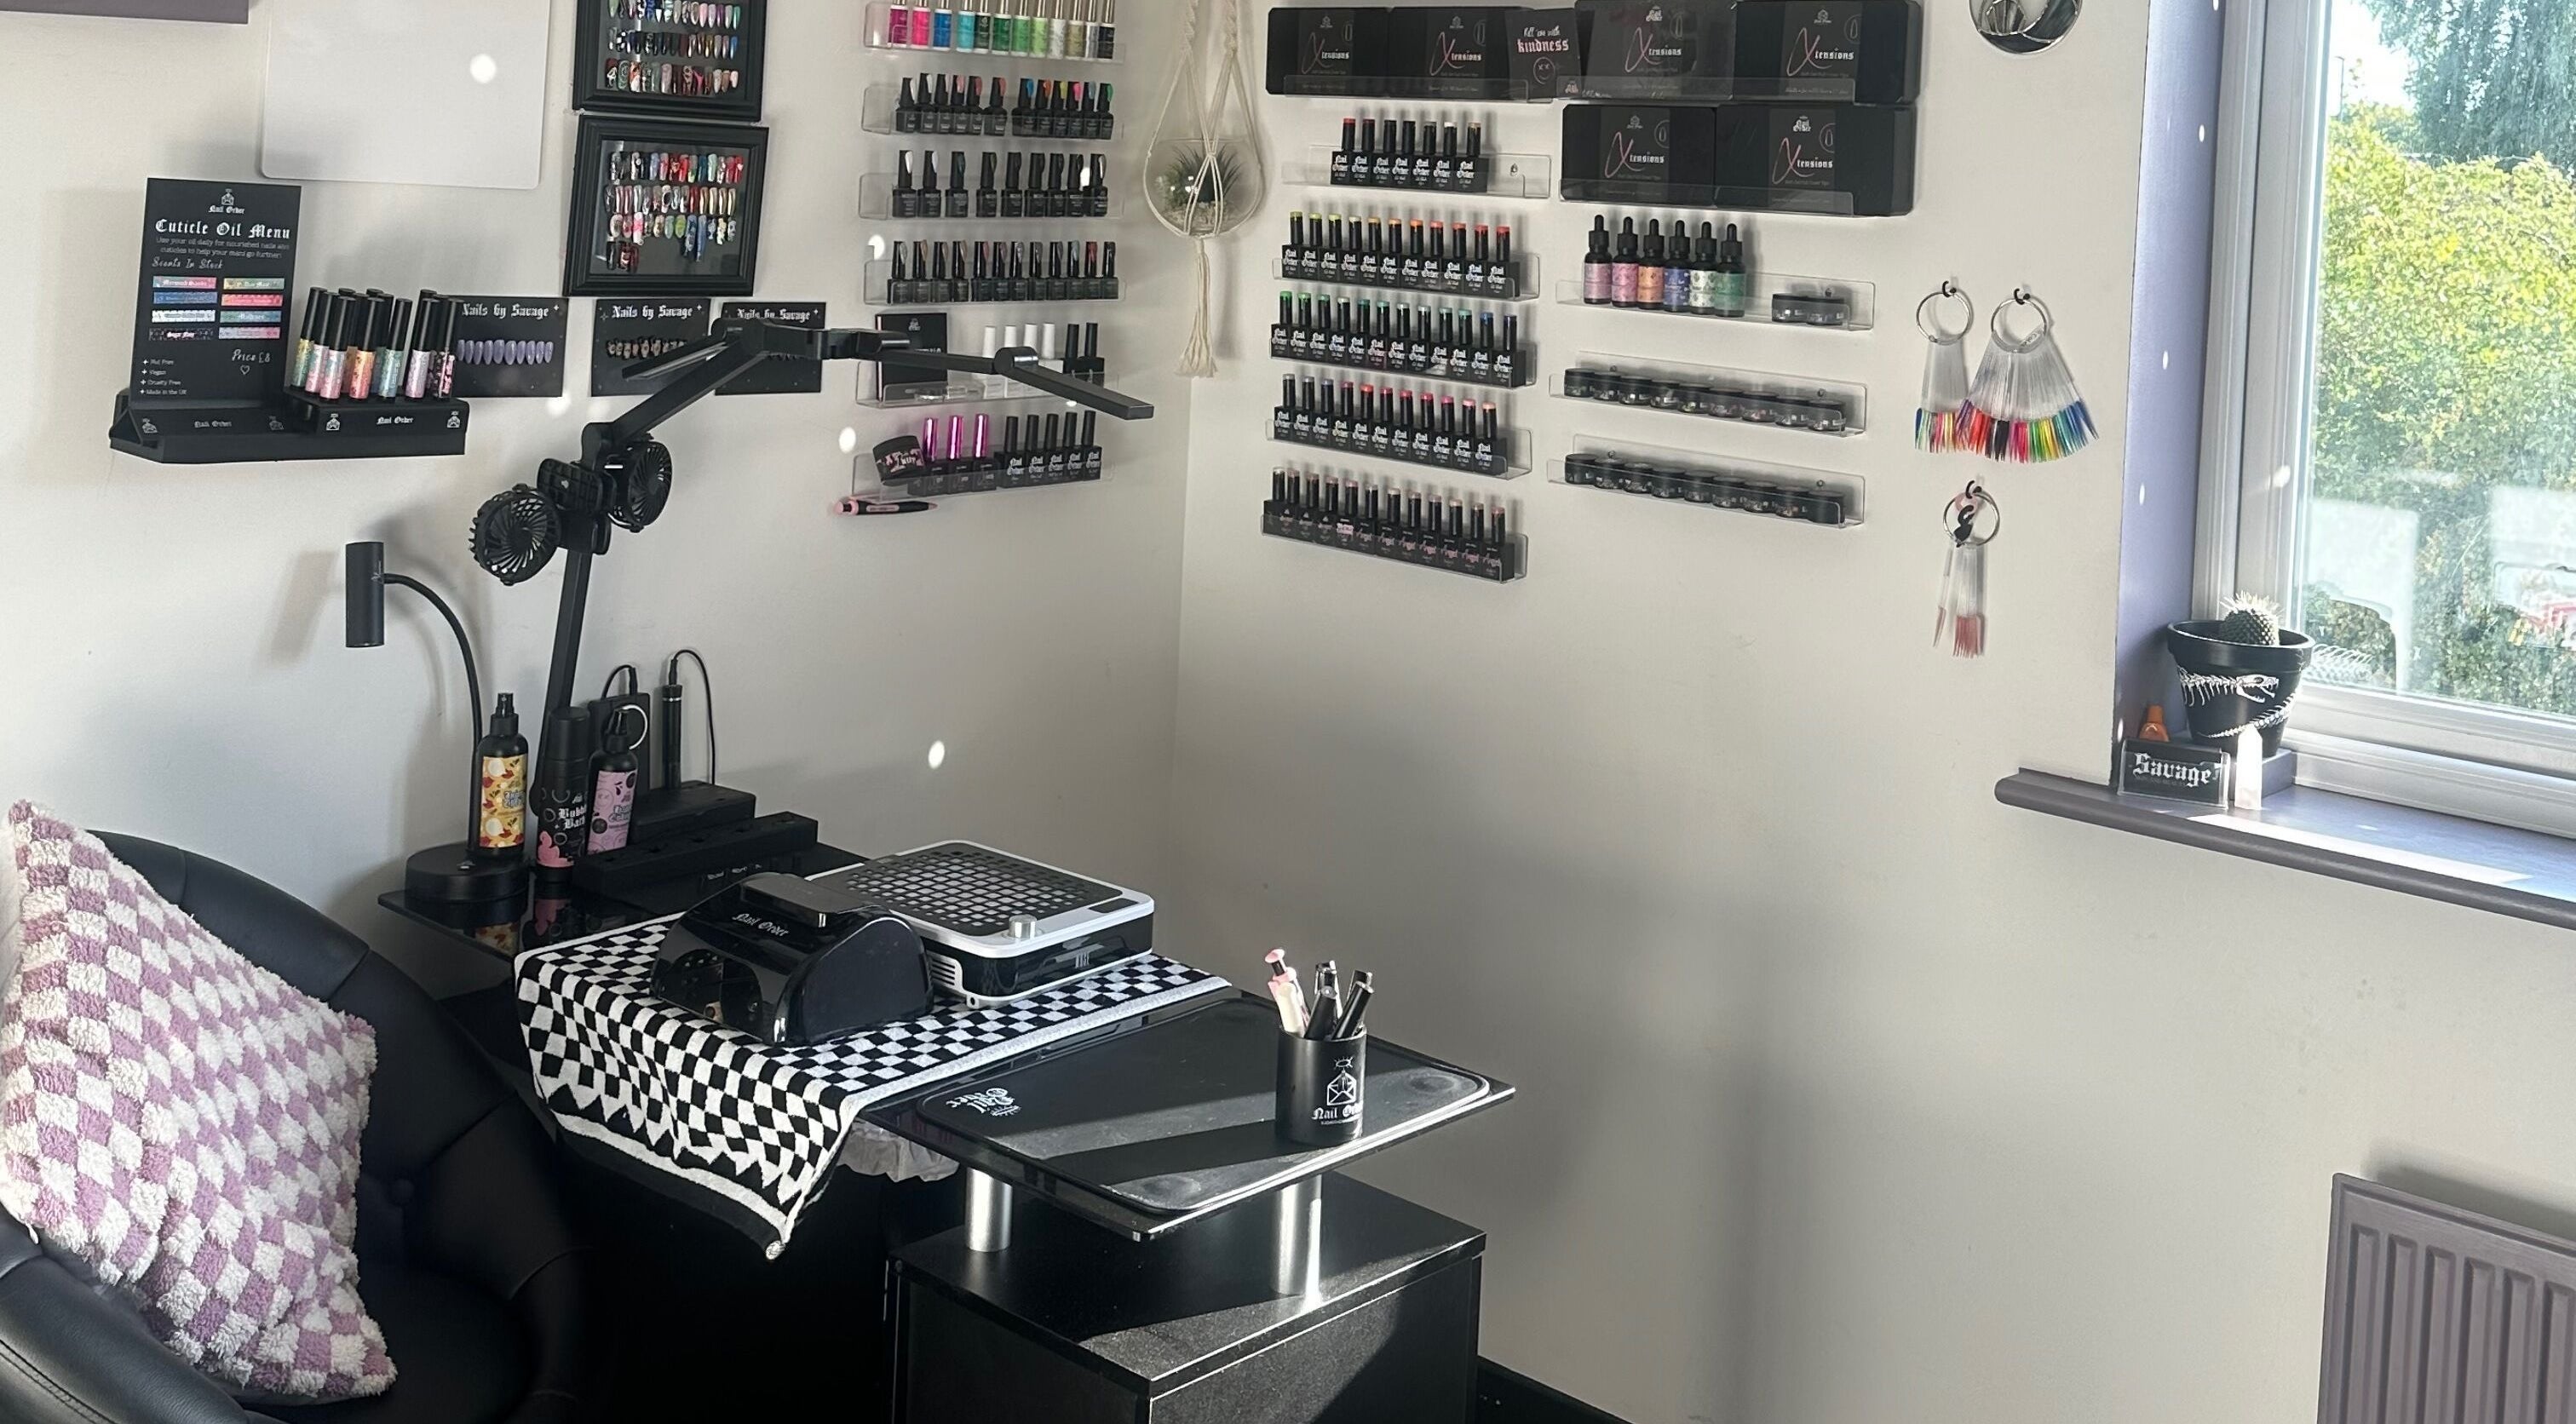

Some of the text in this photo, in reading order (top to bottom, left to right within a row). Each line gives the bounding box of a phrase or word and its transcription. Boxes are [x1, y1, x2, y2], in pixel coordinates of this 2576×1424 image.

[1517, 39, 1569, 53] kindness
[155, 219, 290, 239] Cuticle Oil Menu
[462, 303, 549, 320] Nails by Savage
[612, 304, 693, 320] Nails by Savage
[258, 352, 270, 363] £8
[2133, 753, 2211, 788] Savage
[1312, 1107, 1337, 1120] Nail
